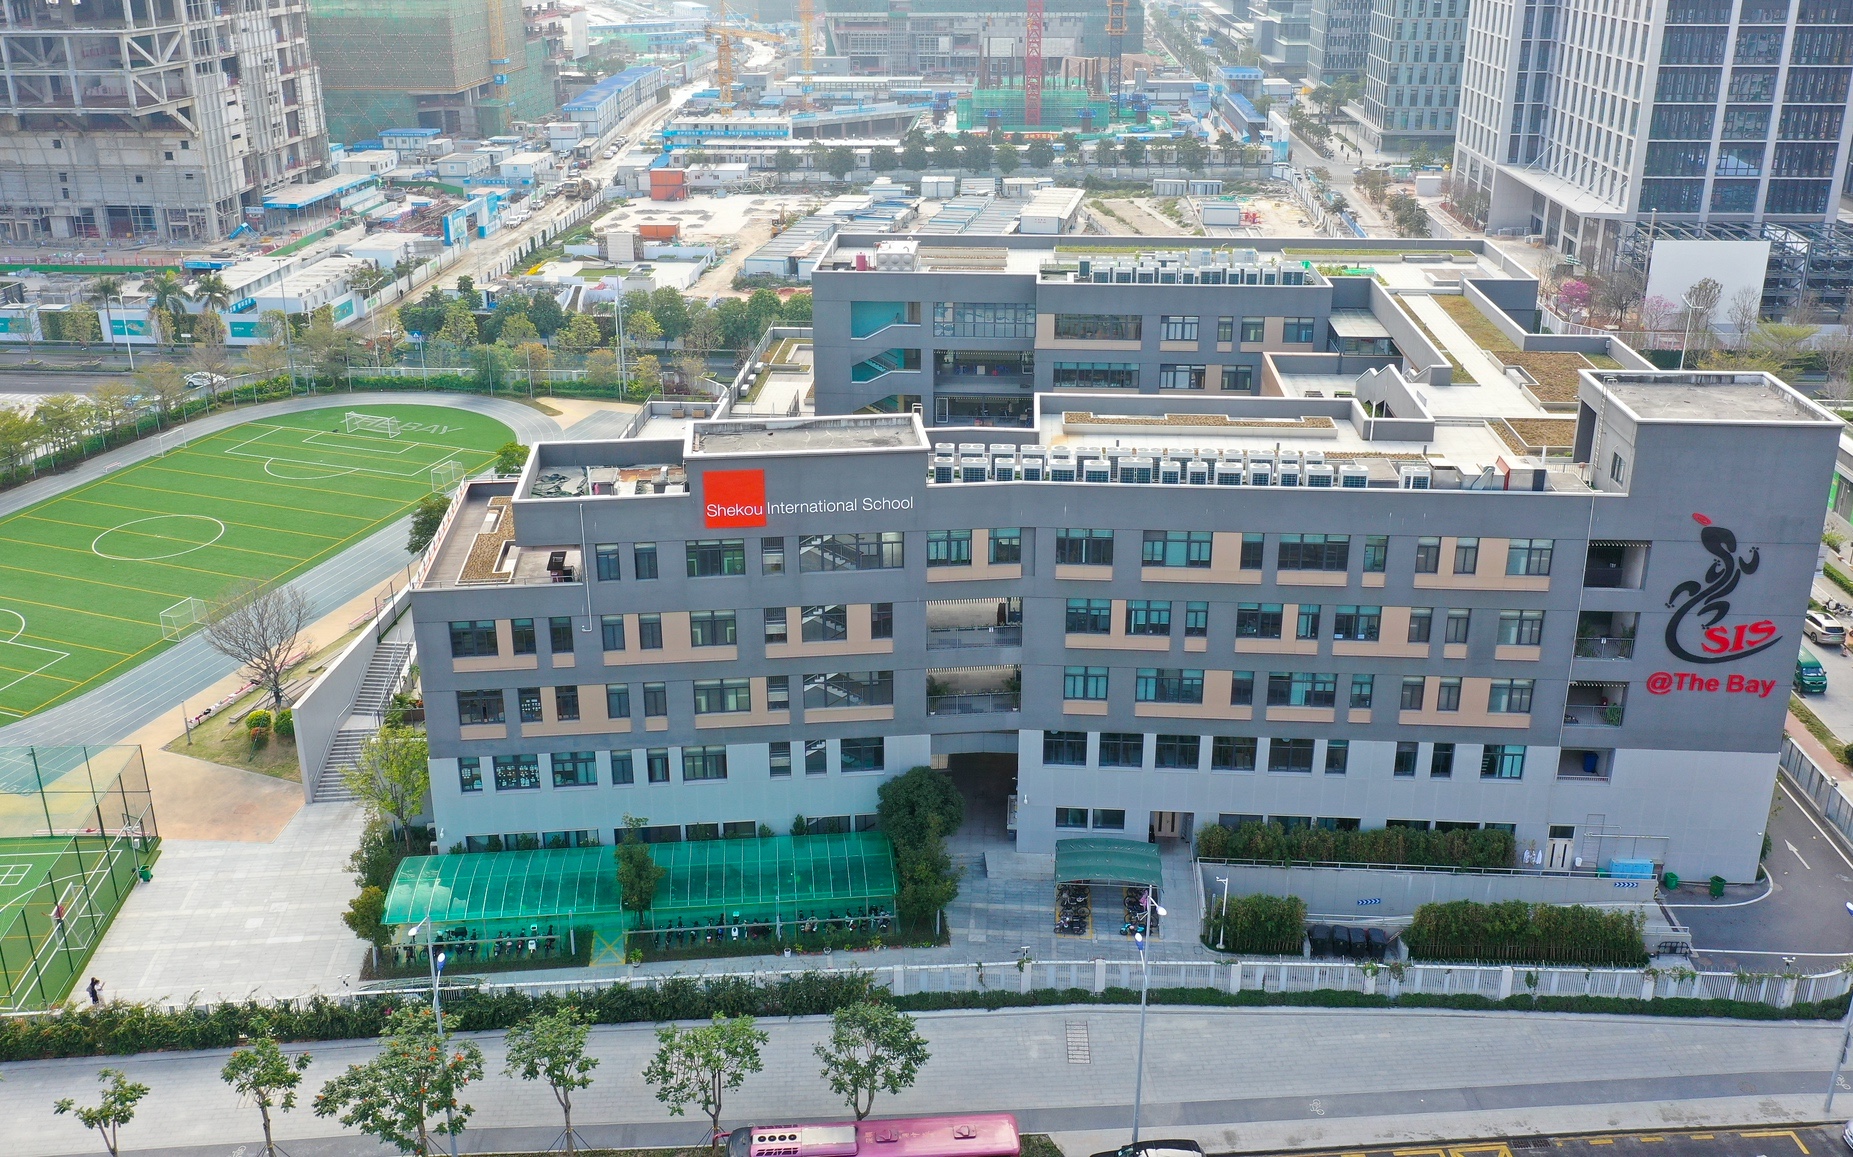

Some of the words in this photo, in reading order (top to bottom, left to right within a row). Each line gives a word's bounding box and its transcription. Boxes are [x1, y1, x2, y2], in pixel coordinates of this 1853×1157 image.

[398, 421, 464, 435] BAY
[706, 503, 763, 517] Shekou
[767, 498, 857, 515] International
[862, 496, 914, 511] School
[1701, 620, 1776, 654] SIS
[1646, 671, 1720, 695] @The
[1726, 674, 1777, 698] Bay
